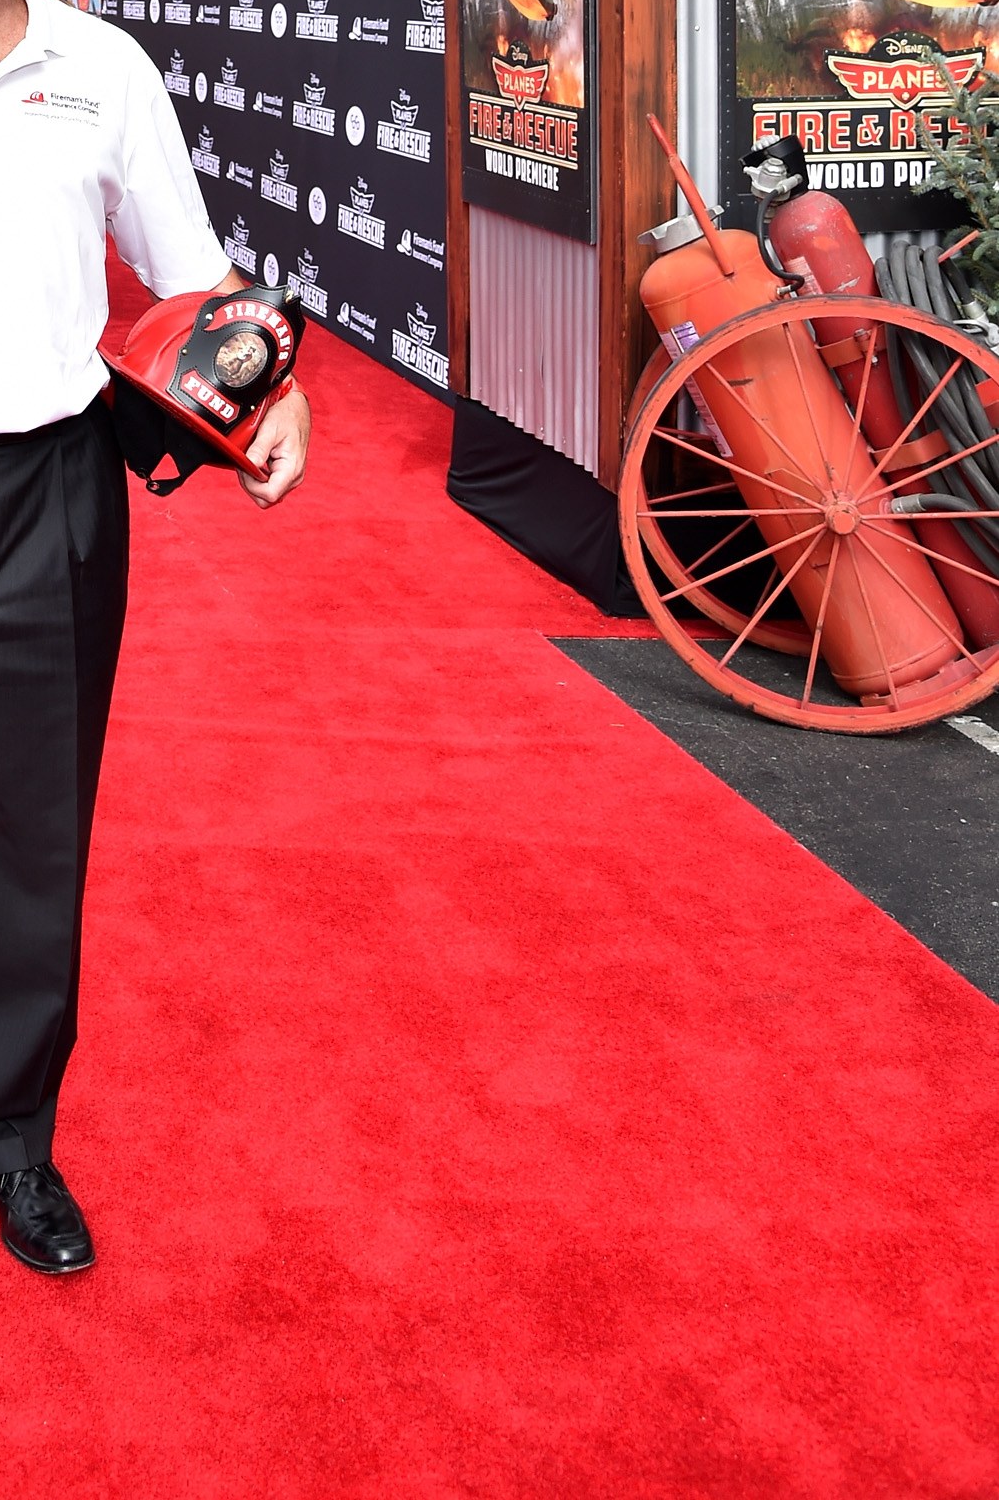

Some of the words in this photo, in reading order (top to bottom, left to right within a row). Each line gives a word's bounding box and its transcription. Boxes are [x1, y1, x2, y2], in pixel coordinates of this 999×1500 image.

[504, 72, 536, 95] PLANES
[377, 124, 394, 148] FIRE
[399, 130, 430, 158] RESCUE
[469, 100, 502, 142] FIRE
[502, 112, 513, 140] &
[514, 110, 578, 162] RESCUE
[753, 111, 852, 153] FIRE
[856, 114, 884, 146] &
[484, 148, 514, 178] WORLD
[515, 156, 560, 192] PREMIERE
[806, 162, 884, 190] WORLD
[223, 302, 293, 361] FIREMAN'S
[392, 333, 411, 364] FIRE
[416, 345, 448, 386] RESCUE
[184, 376, 236, 420] FUND
